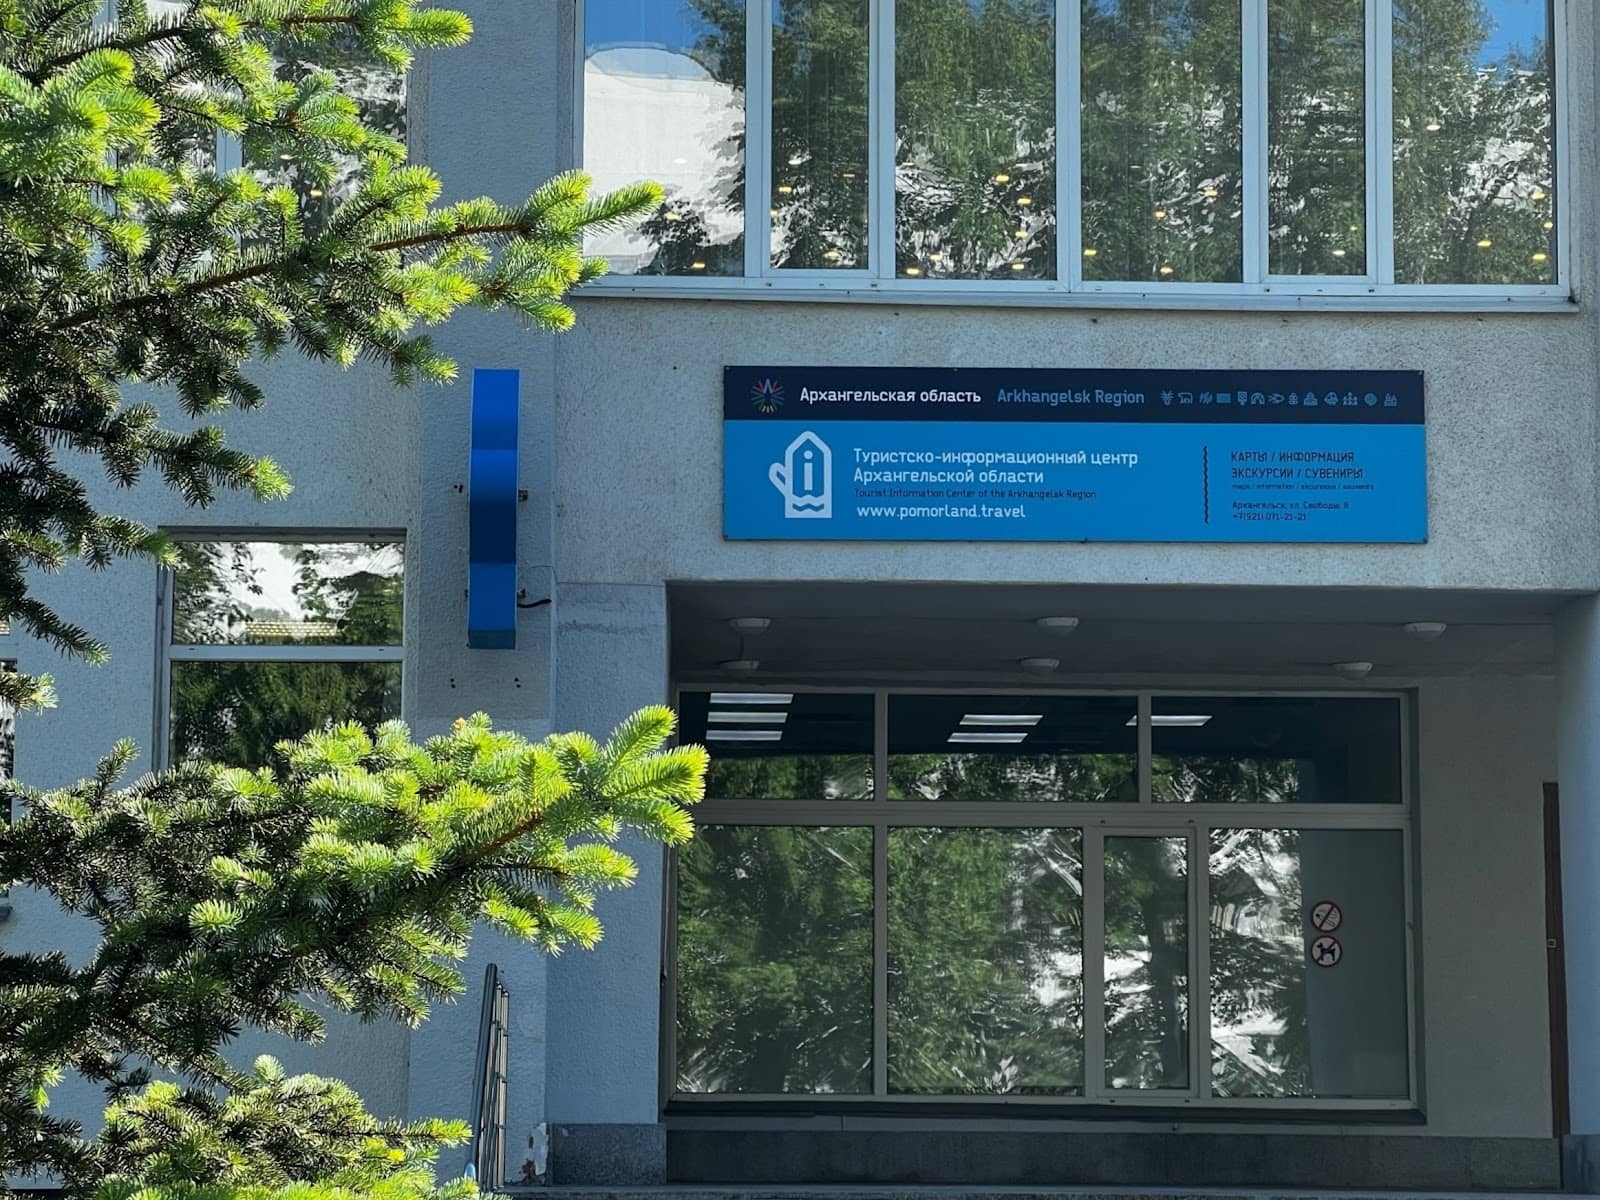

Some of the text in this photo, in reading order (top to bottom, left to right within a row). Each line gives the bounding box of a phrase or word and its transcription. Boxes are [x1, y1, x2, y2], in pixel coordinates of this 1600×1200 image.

[800, 386, 982, 404] Архангельская область
[997, 388, 1145, 406] Arkhangelsk Region
[853, 448, 1138, 468] Туристско-информационный центр
[1231, 451, 1267, 463] КАРТЫ
[1279, 451, 1354, 463] ИНФОРМАЦИЯ
[853, 468, 1044, 485] Архангельской области
[1231, 468, 1294, 479] ЭКСКУРСИИ
[1304, 468, 1364, 479] СУВЕНИРЫ
[854, 488, 1097, 500] Tourist Information Center of the Arkhangelsk Region
[857, 504, 1026, 520] www.pomorland.travel
